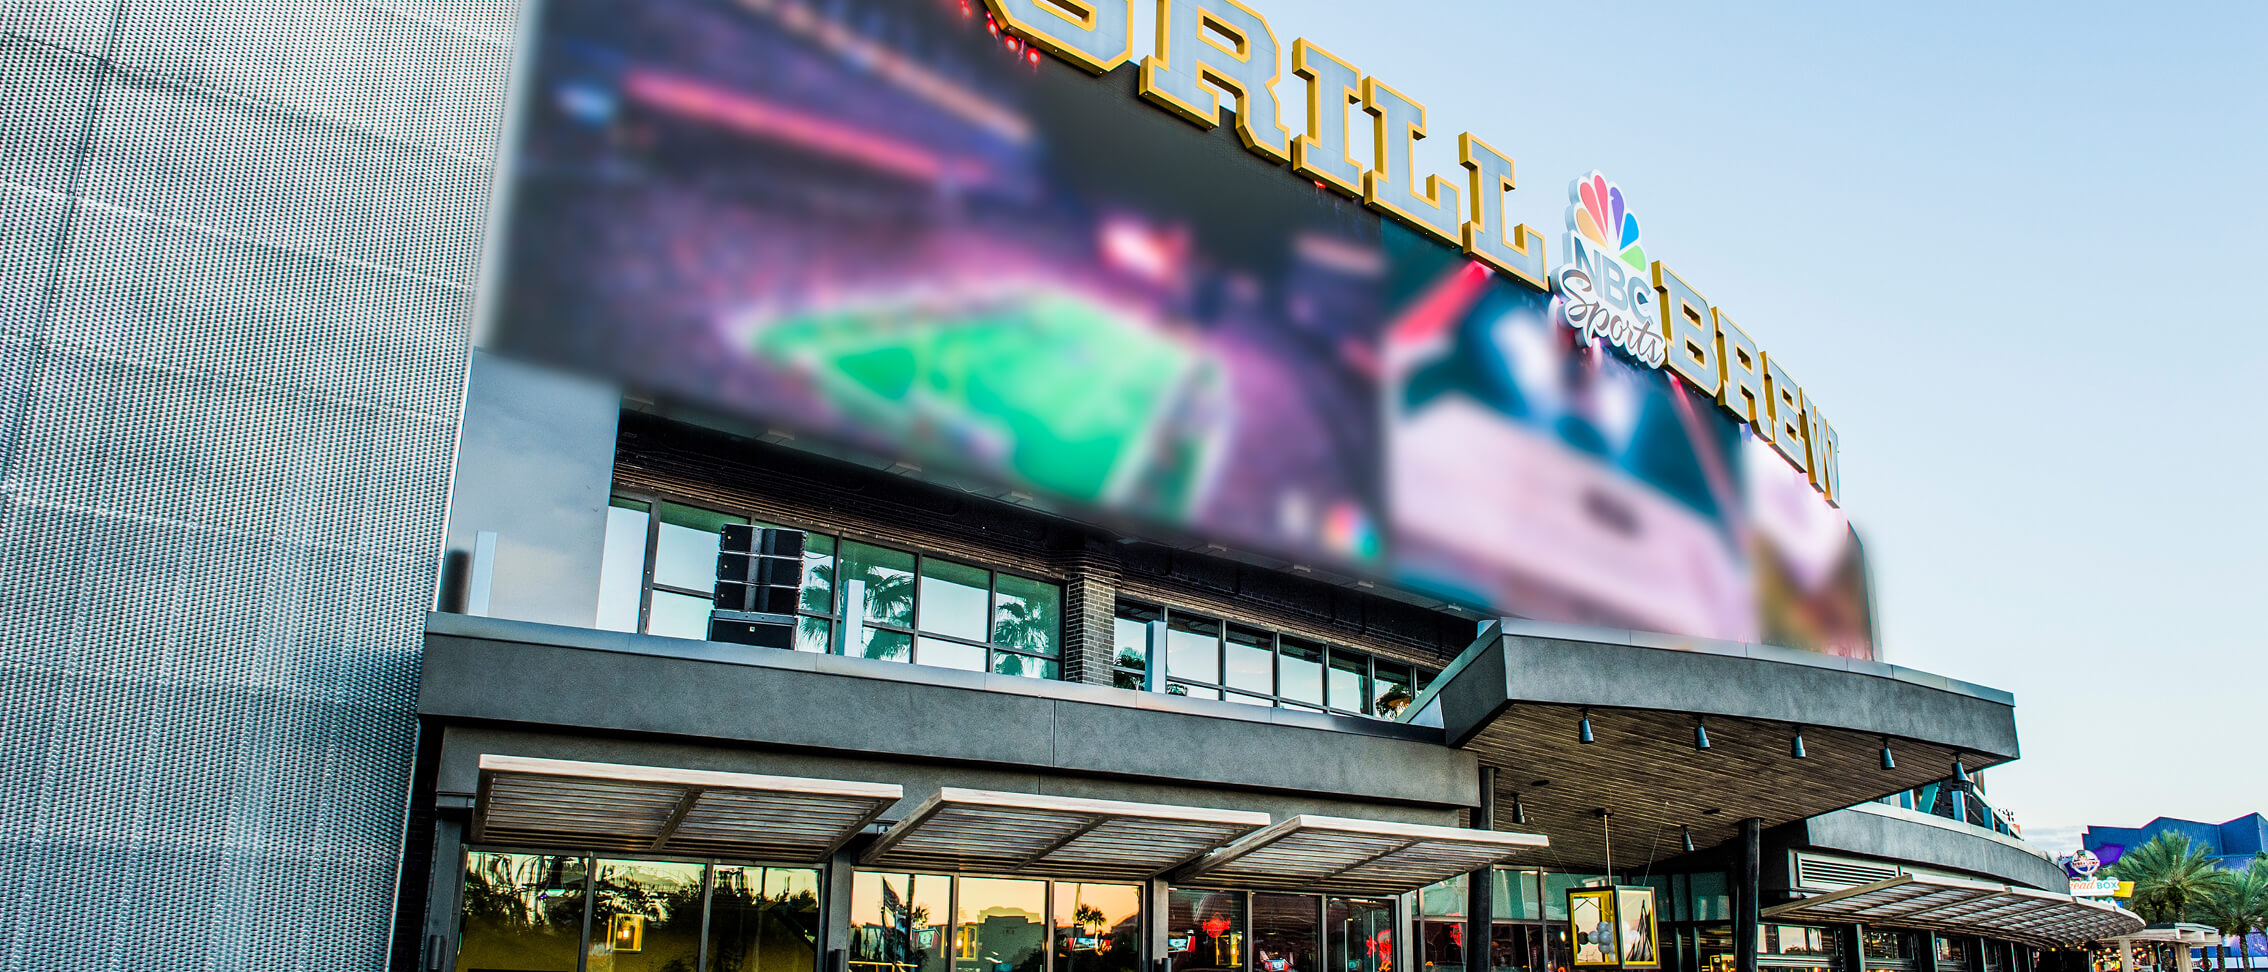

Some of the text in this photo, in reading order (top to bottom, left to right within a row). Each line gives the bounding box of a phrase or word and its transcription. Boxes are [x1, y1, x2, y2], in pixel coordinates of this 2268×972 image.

[1561, 269, 1663, 363] Sports
[1574, 236, 1654, 325] NBC
[1651, 260, 1840, 509] BREW
[2096, 881, 2118, 889] BOX
